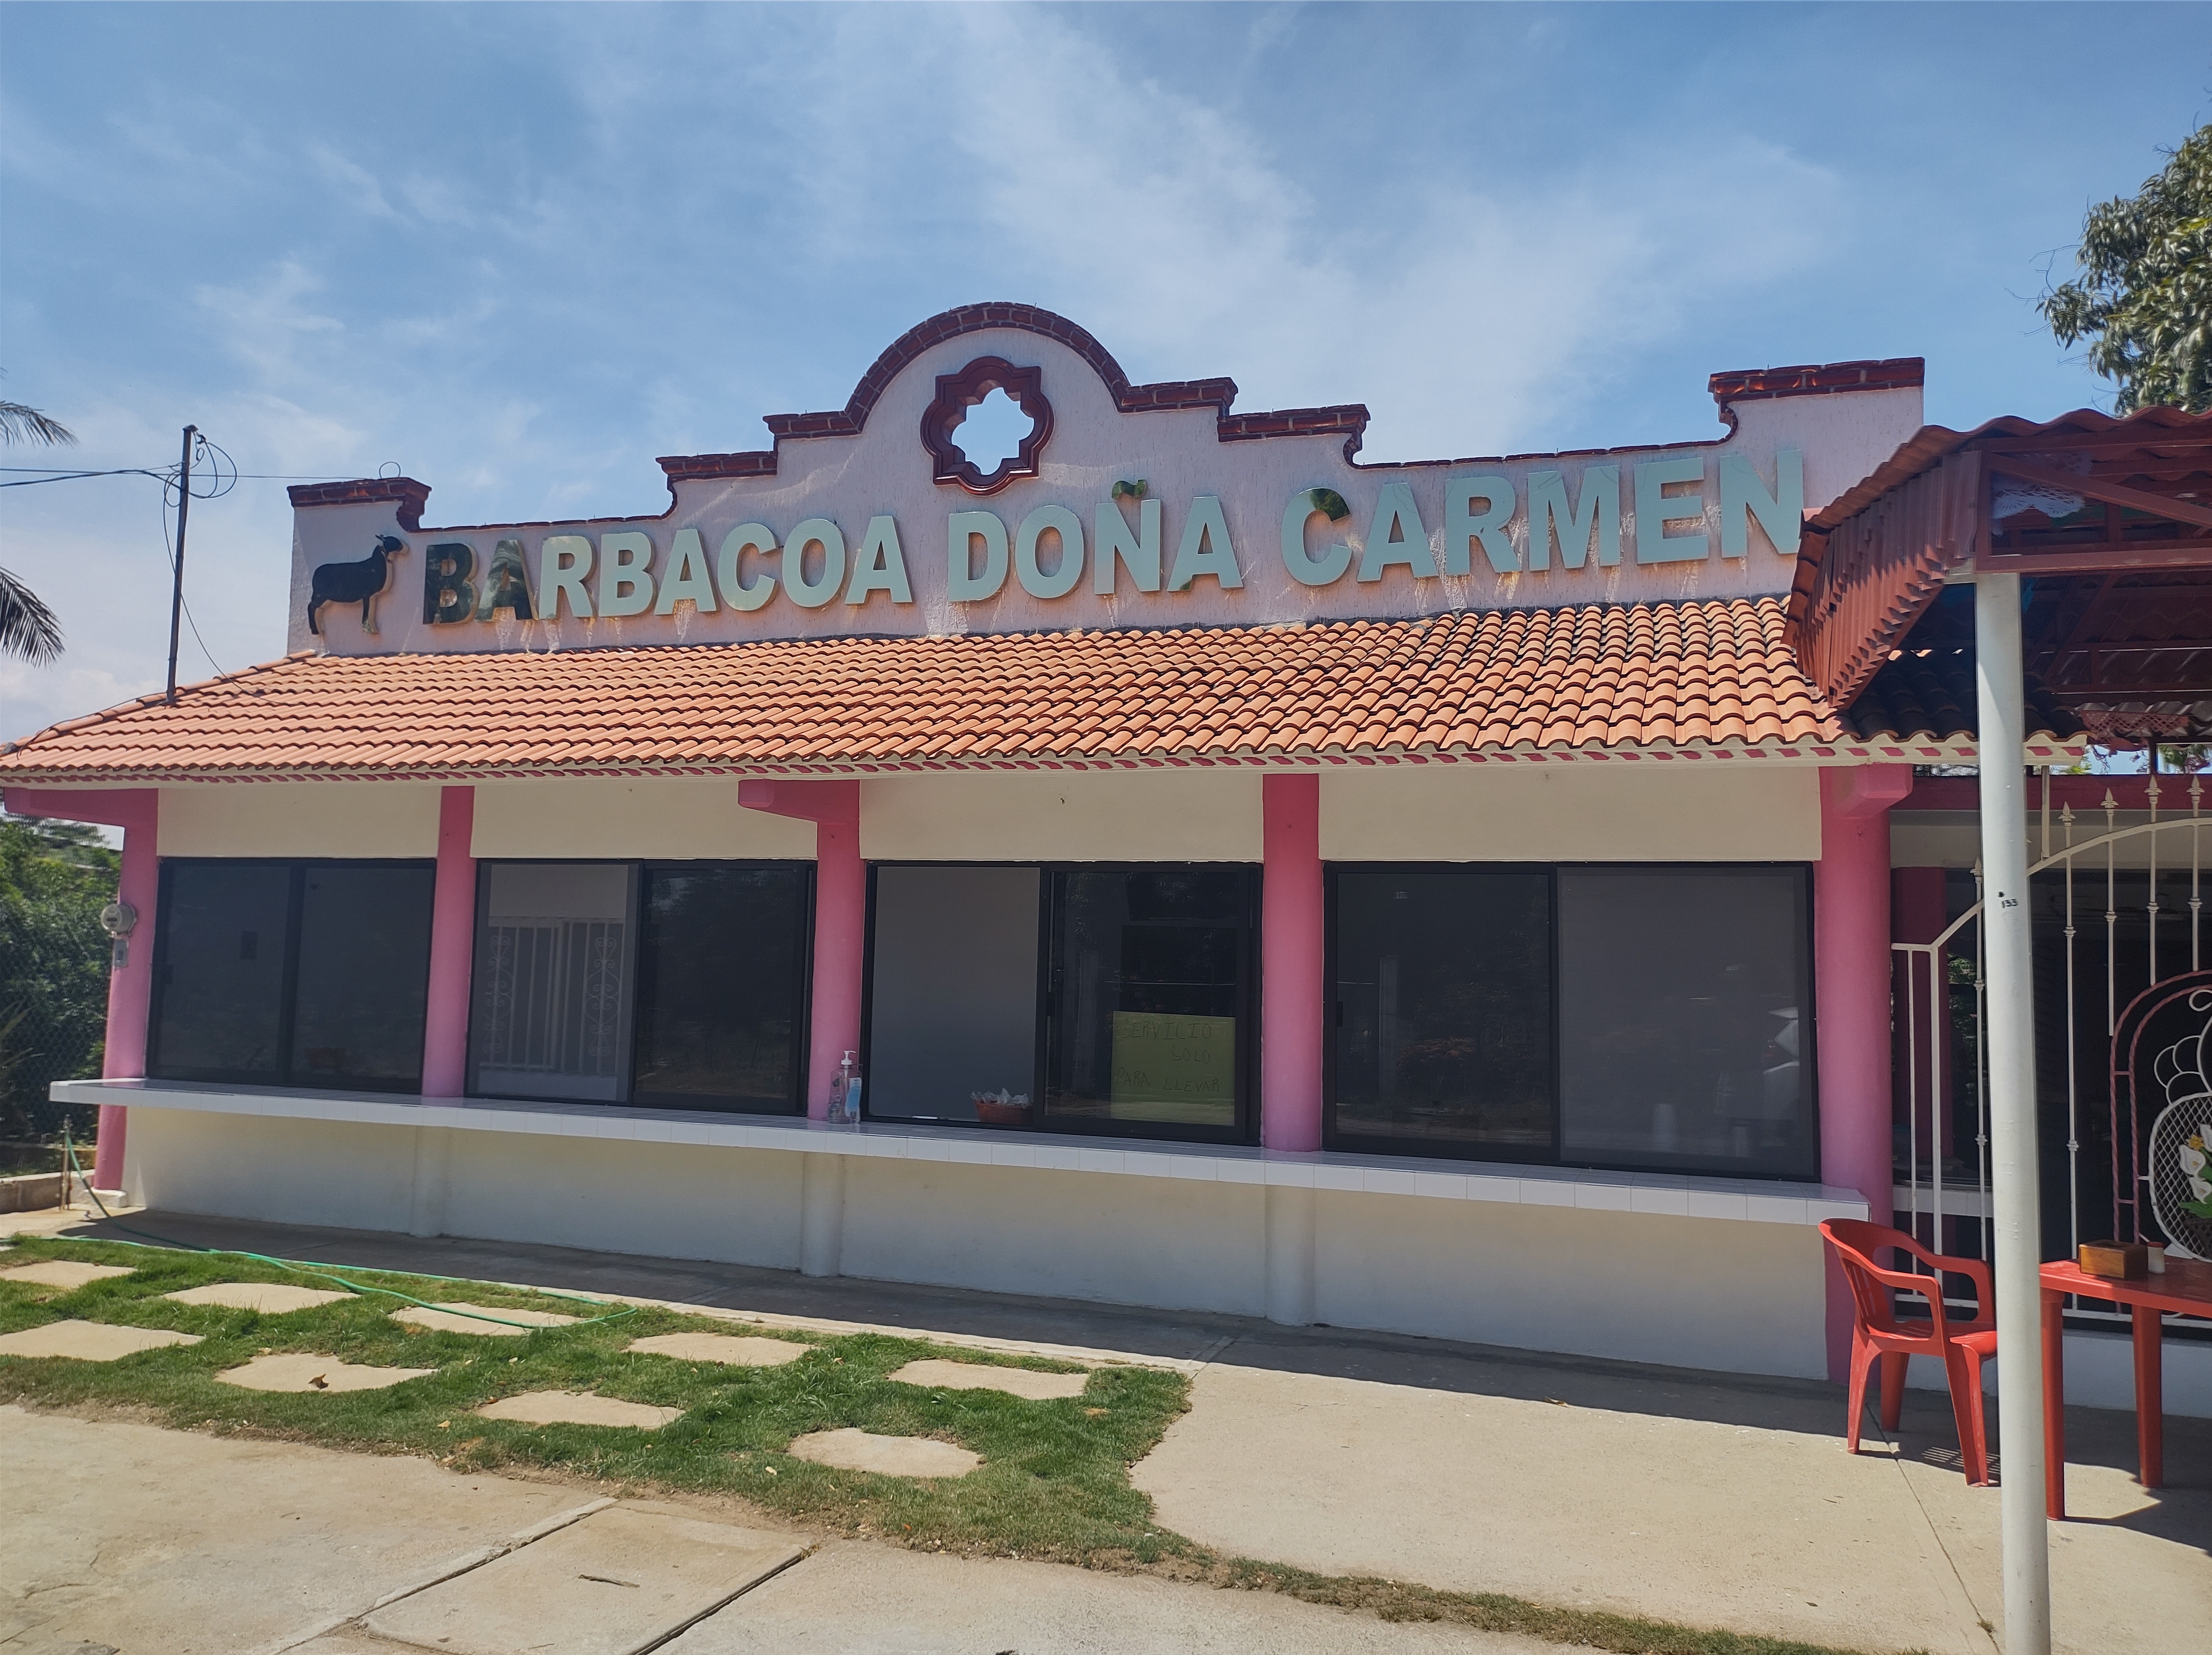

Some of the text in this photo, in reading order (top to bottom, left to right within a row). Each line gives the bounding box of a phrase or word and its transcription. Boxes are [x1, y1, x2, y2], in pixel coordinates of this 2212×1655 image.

[422, 449, 1805, 625] BARBACOA DOÑA CARMEN
[1120, 1020, 1212, 1040] SERVICIO
[1171, 1044, 1210, 1064] SOLO
[1116, 1067, 1219, 1093] PARA LLEVAR
